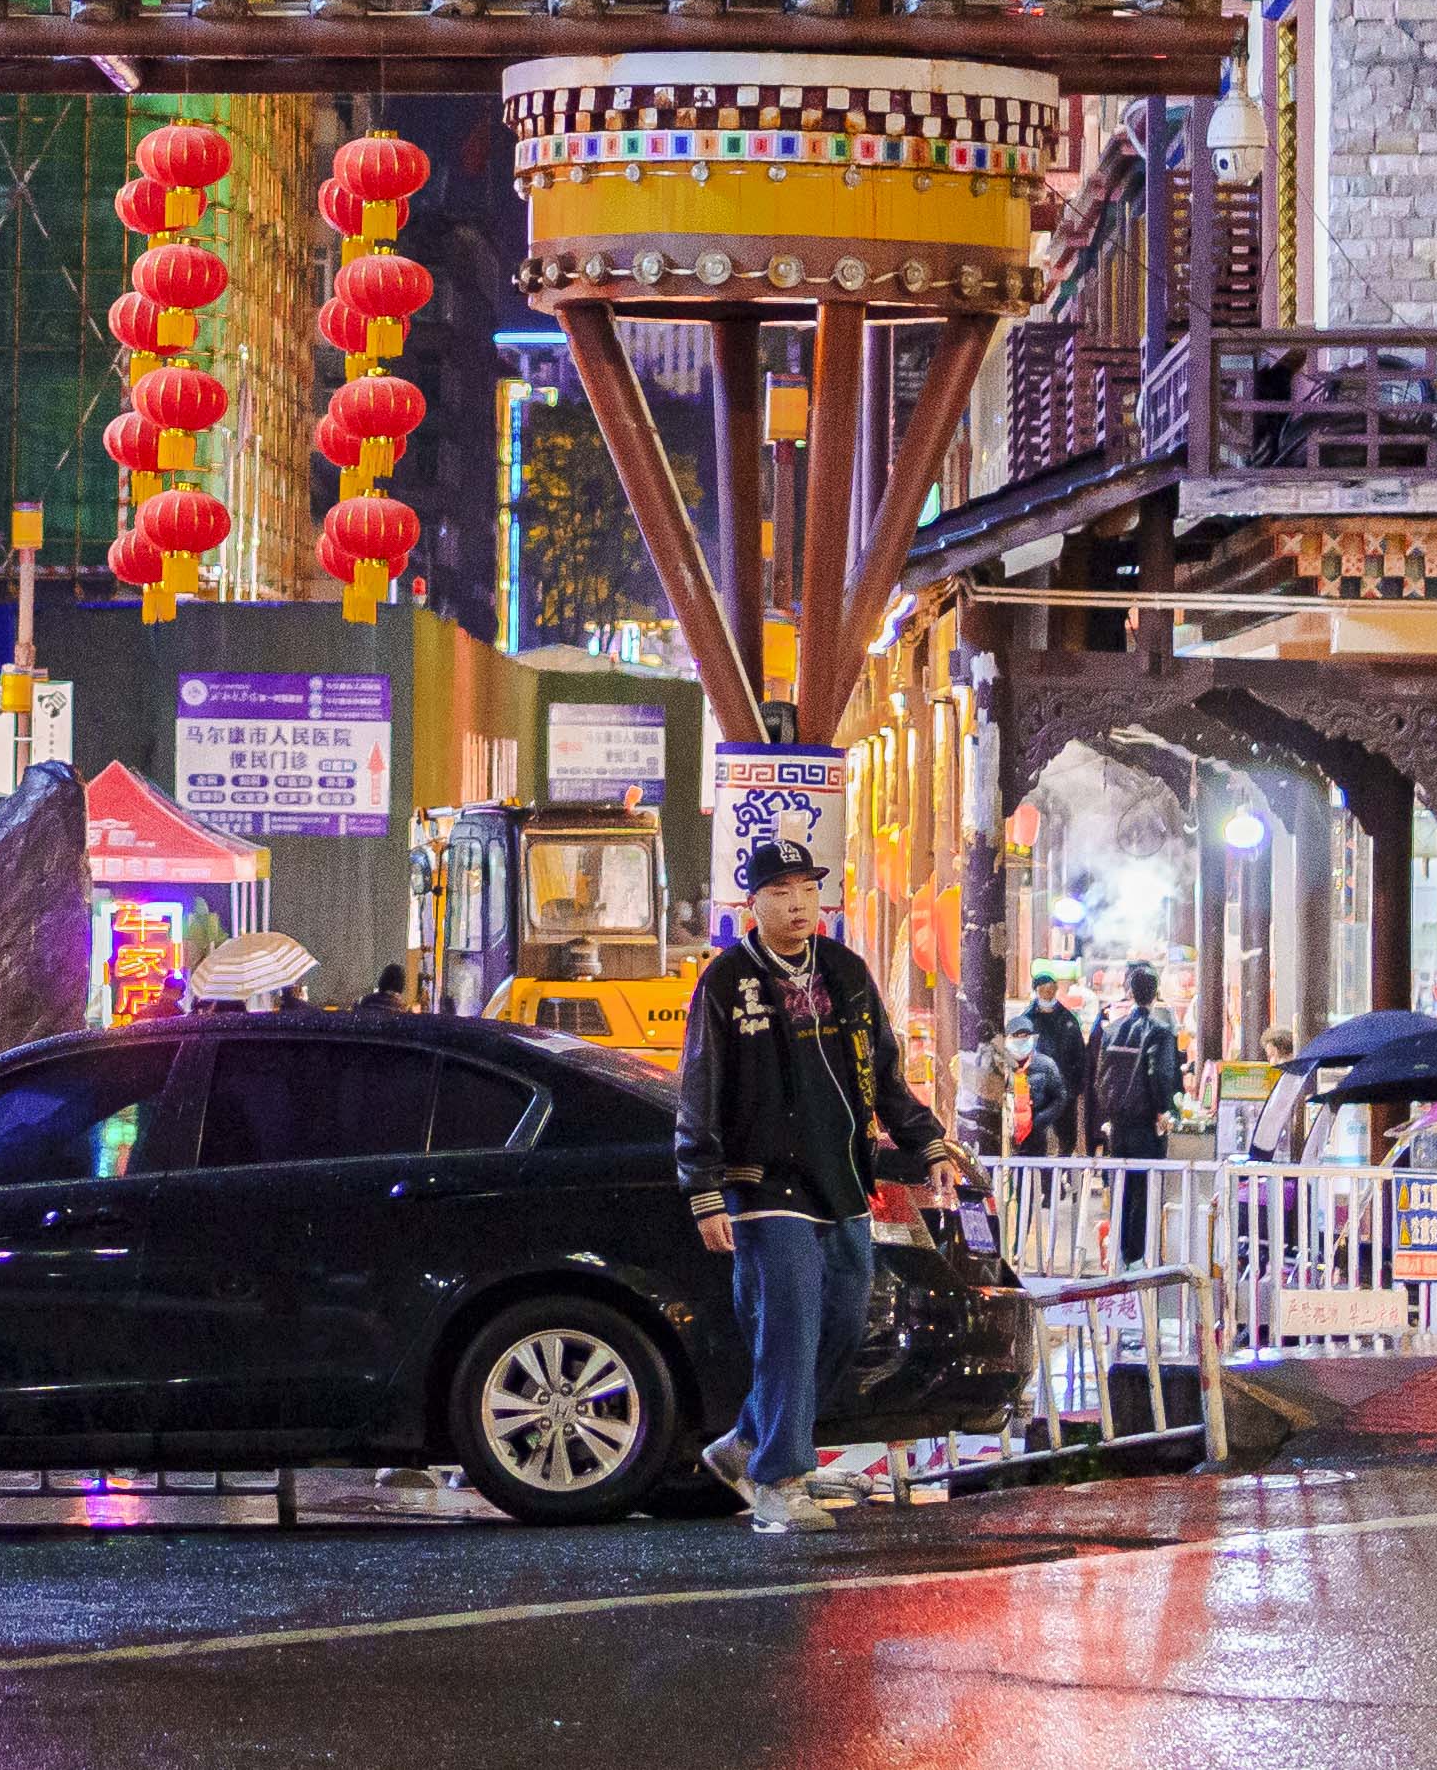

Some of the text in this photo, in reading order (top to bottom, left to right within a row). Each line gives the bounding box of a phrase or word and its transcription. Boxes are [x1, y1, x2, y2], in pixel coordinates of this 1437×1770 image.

[186, 725, 352, 748] 马尔康市人民医院
[229, 749, 309, 771] 便民门诊
